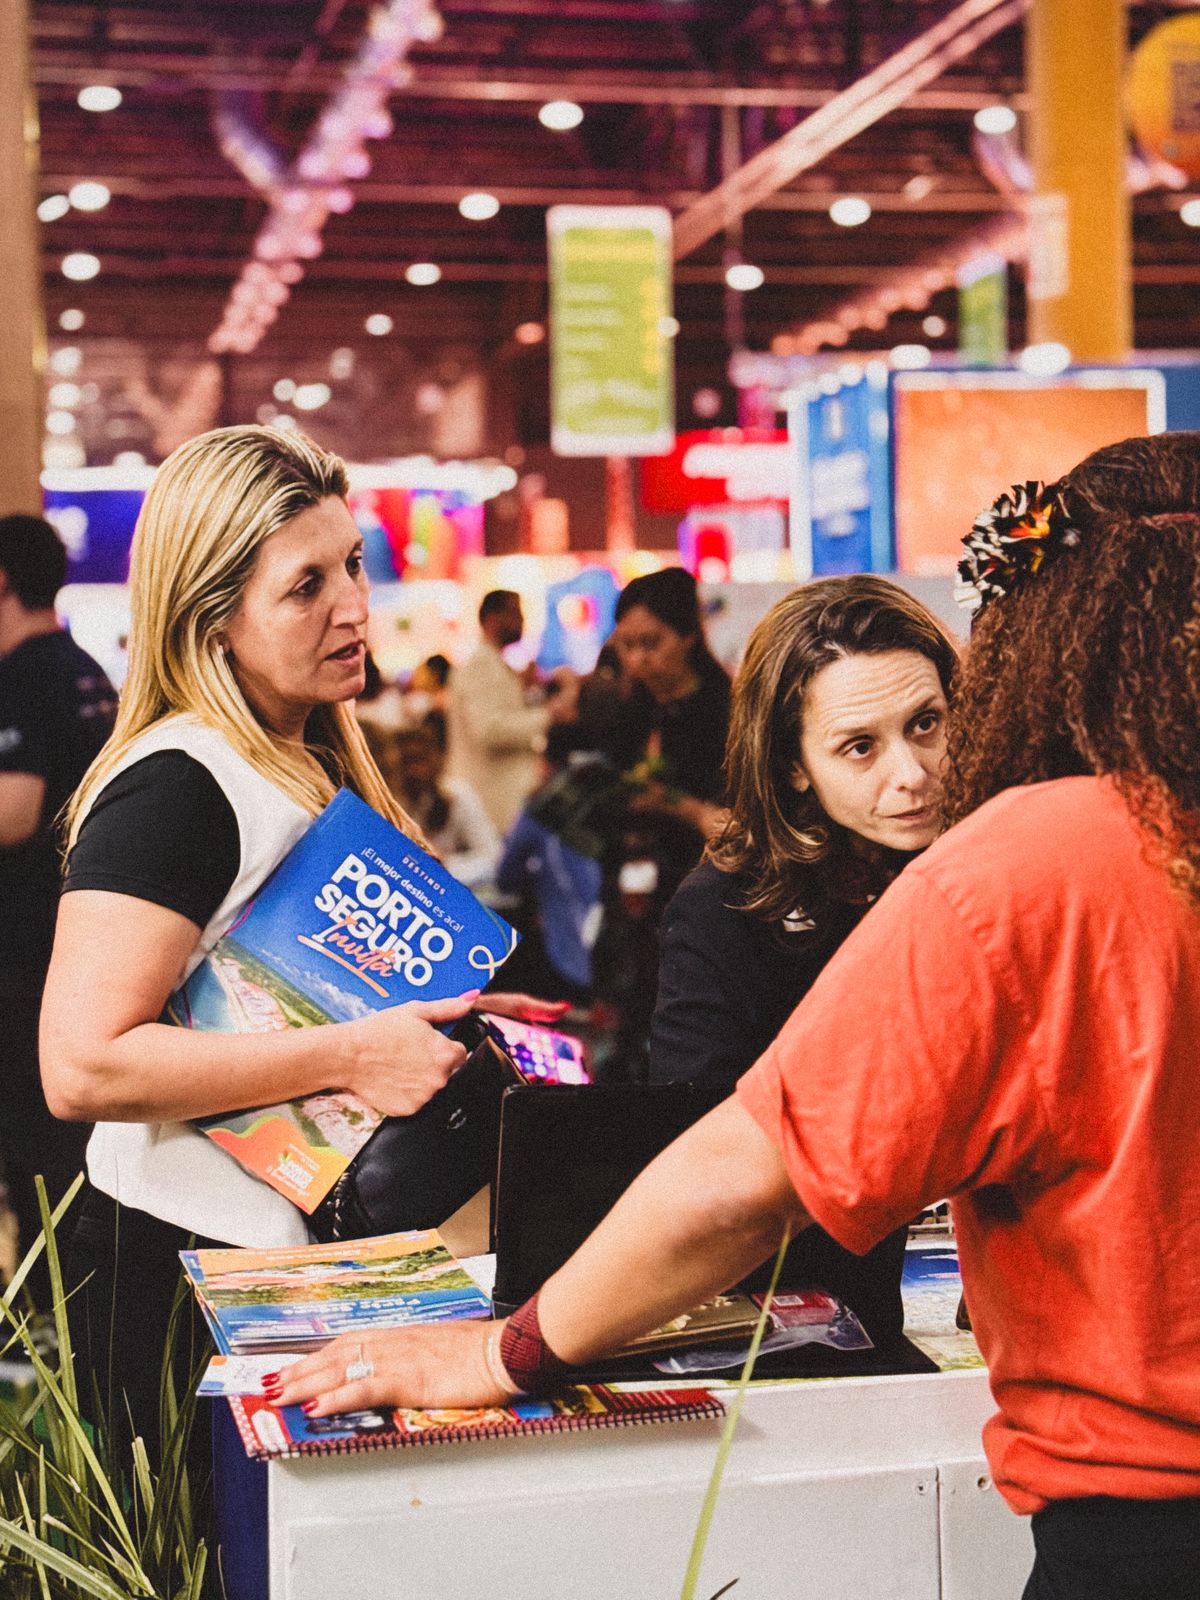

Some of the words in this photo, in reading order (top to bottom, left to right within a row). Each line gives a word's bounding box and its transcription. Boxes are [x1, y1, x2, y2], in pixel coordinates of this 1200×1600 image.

[331, 853, 454, 962] PORTO
[374, 857, 403, 881] mejor
[401, 879, 433, 908] destino
[433, 906, 446, 918] es
[402, 856, 446, 895] DESTINOS
[314, 883, 433, 987] SEGURO
